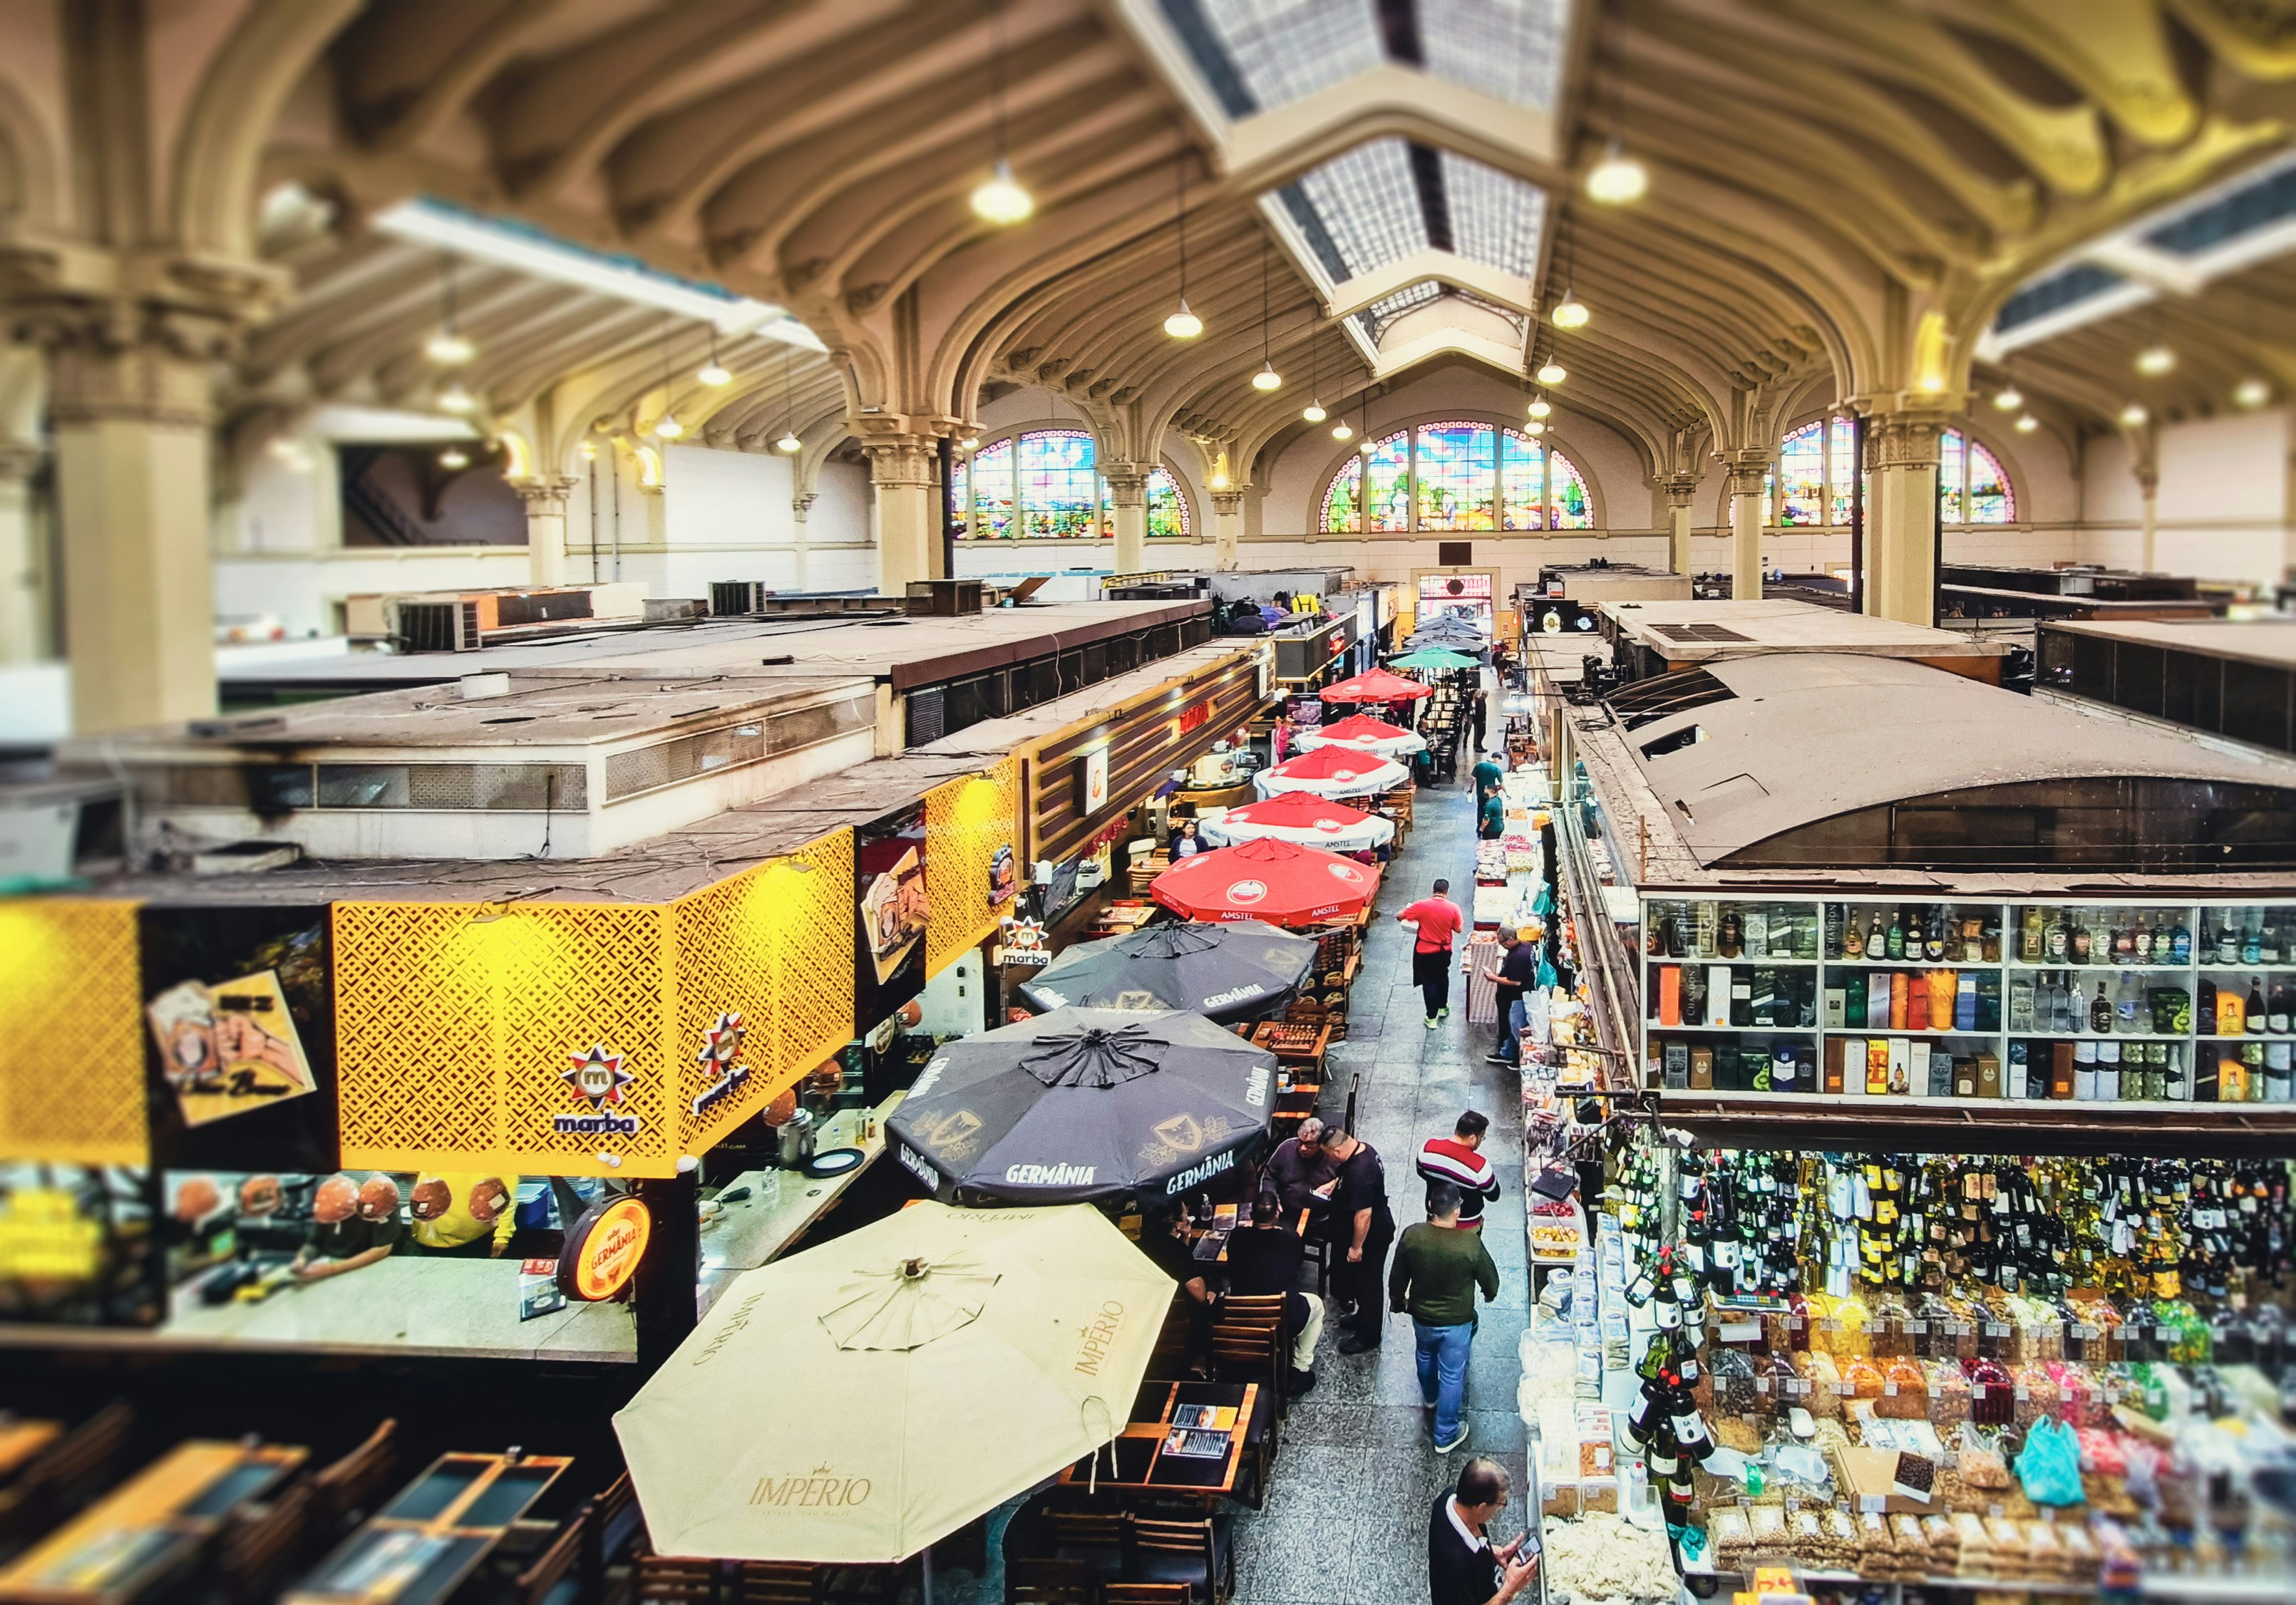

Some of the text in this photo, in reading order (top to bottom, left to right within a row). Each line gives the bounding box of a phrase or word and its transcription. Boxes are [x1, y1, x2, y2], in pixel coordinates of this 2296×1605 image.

[1221, 912, 1252, 920] AMSTEL
[1312, 905, 1339, 917] AMSTEL
[1004, 954, 1049, 965] marba
[1203, 983, 1265, 1008] GERMÂNIA
[1687, 971, 1696, 1016] CHANDON
[554, 1113, 635, 1132] marba
[900, 1142, 939, 1191] GERMÂNIA
[1005, 1162, 1096, 1185] GERMÂNIA
[1166, 1150, 1234, 1194] GERMÂNIA
[591, 1227, 637, 1270] GERMÂNIA
